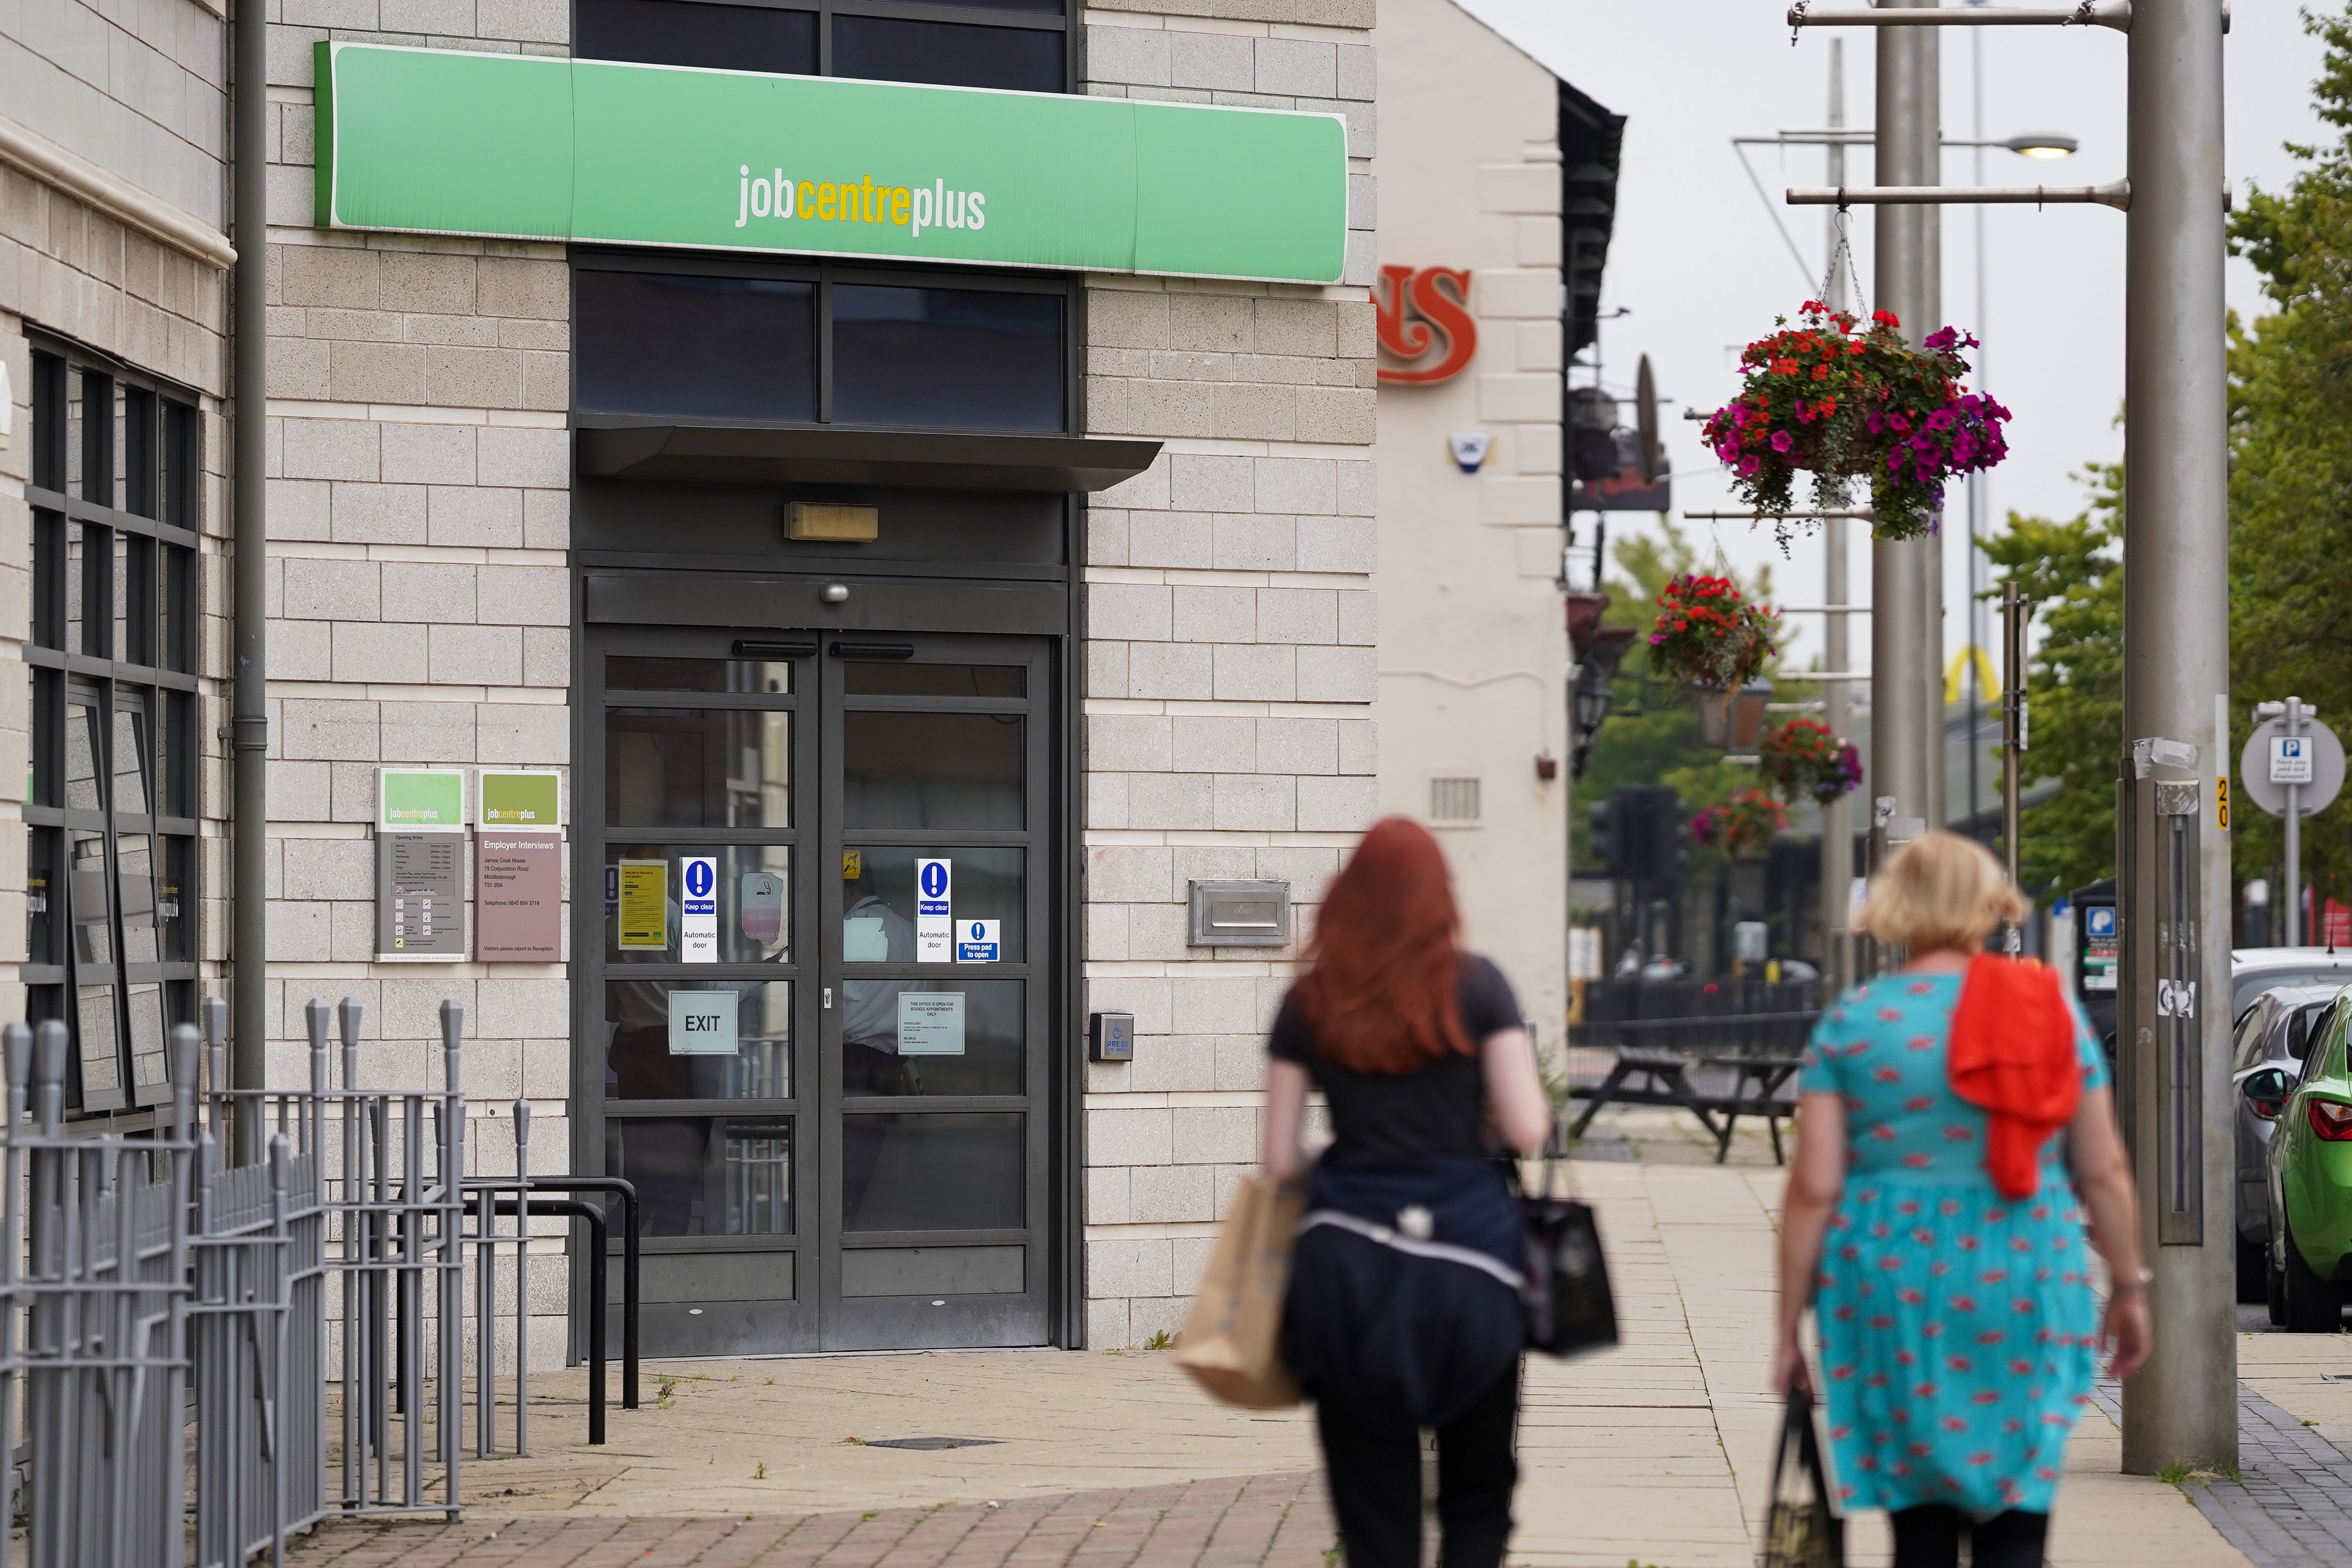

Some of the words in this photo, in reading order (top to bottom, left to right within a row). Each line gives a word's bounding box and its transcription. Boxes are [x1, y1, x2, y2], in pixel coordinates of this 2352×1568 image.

[735, 165, 986, 238] jobcentreplus
[2286, 740, 2298, 755] P
[389, 808, 438, 820] jobcentreplus
[487, 808, 535, 821] jobcentreplus
[484, 840, 517, 850] Employer
[519, 841, 554, 849] Interviews
[685, 1015, 721, 1032] EXIT
